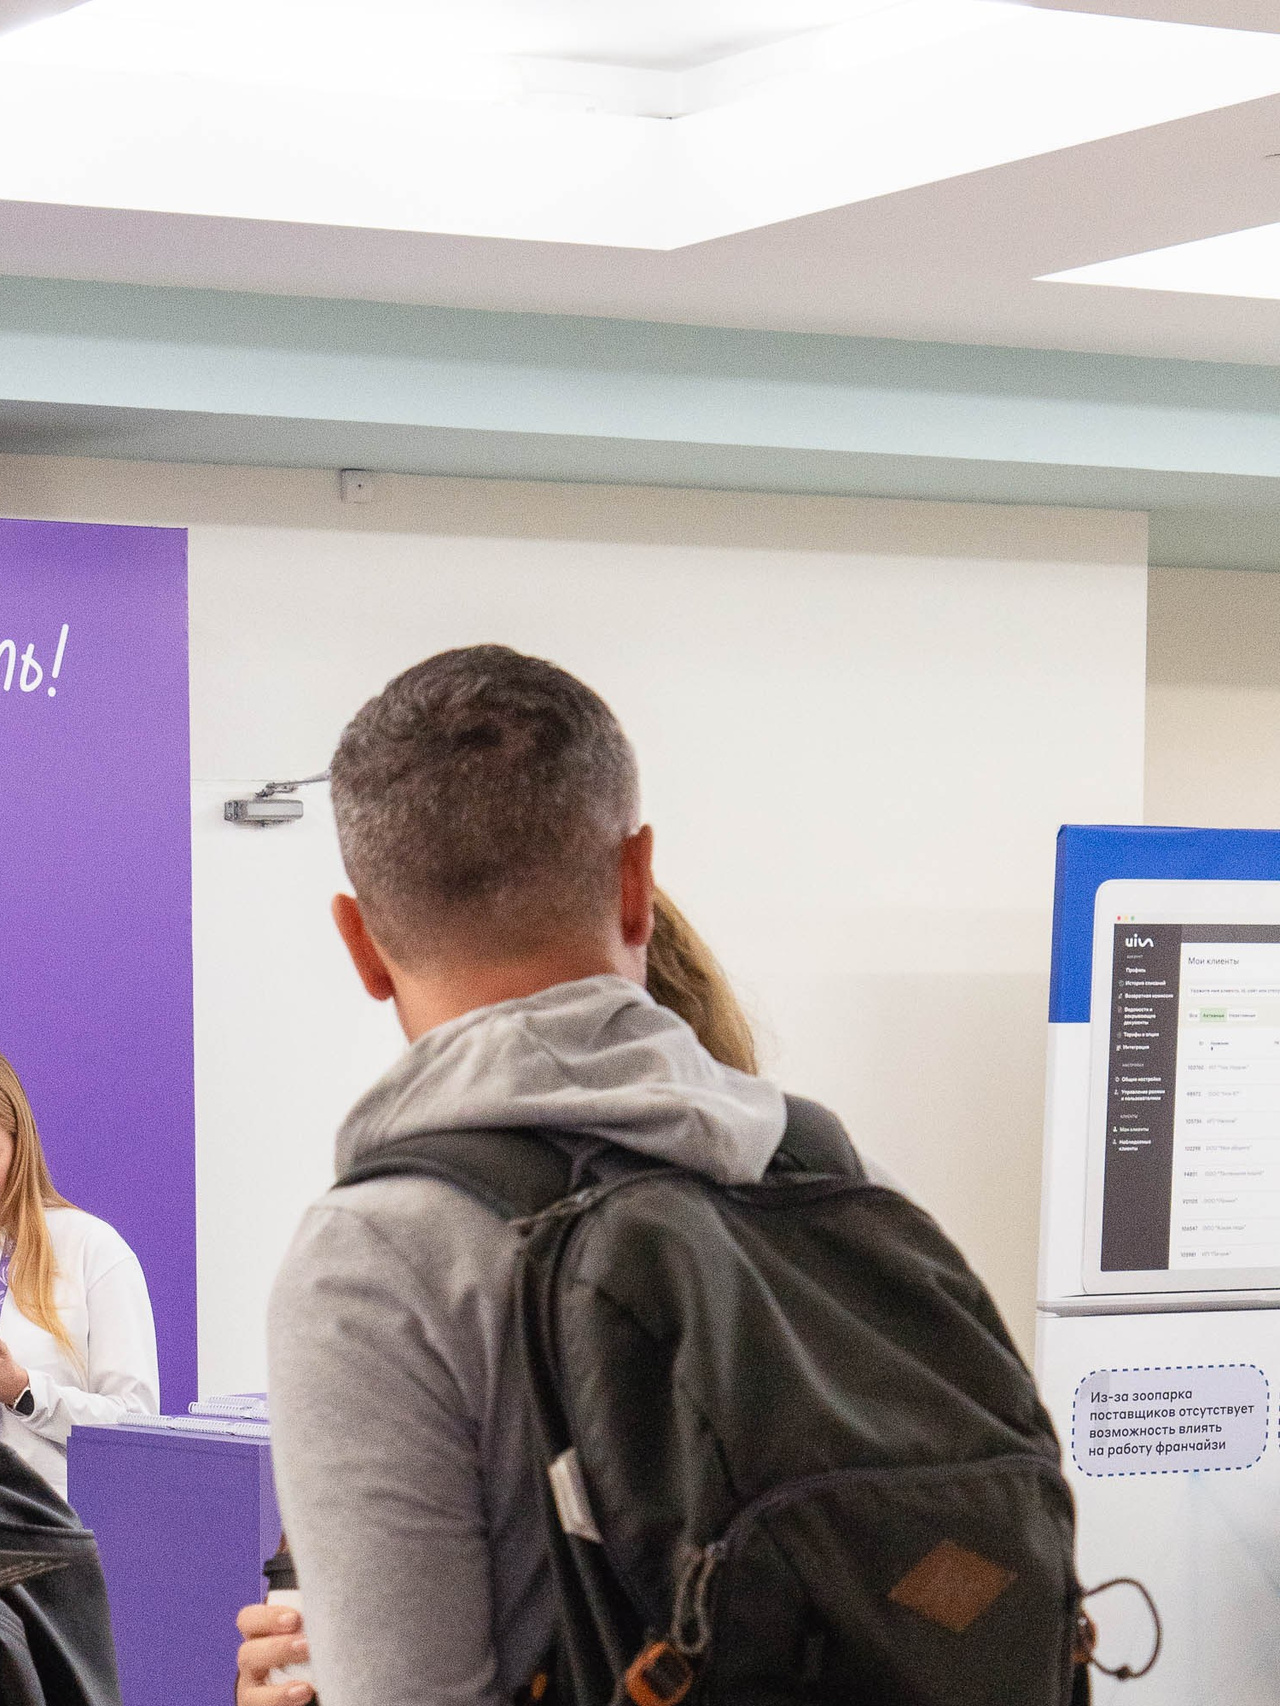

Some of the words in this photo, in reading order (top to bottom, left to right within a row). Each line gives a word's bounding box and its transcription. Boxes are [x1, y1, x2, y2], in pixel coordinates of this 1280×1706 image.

[1188, 957, 1205, 965] Мои
[1206, 957, 1240, 966] клиенты
[1090, 1391, 1129, 1404] Из-за
[1132, 1389, 1193, 1403] зоопарка
[1089, 1407, 1176, 1421] поставщиков
[1178, 1404, 1255, 1419] отсутствует
[1089, 1425, 1176, 1439] возможность
[1178, 1424, 1223, 1435] влиять
[1088, 1446, 1104, 1457] на
[1107, 1442, 1152, 1458] работу
[1155, 1439, 1227, 1456] франчайзи
